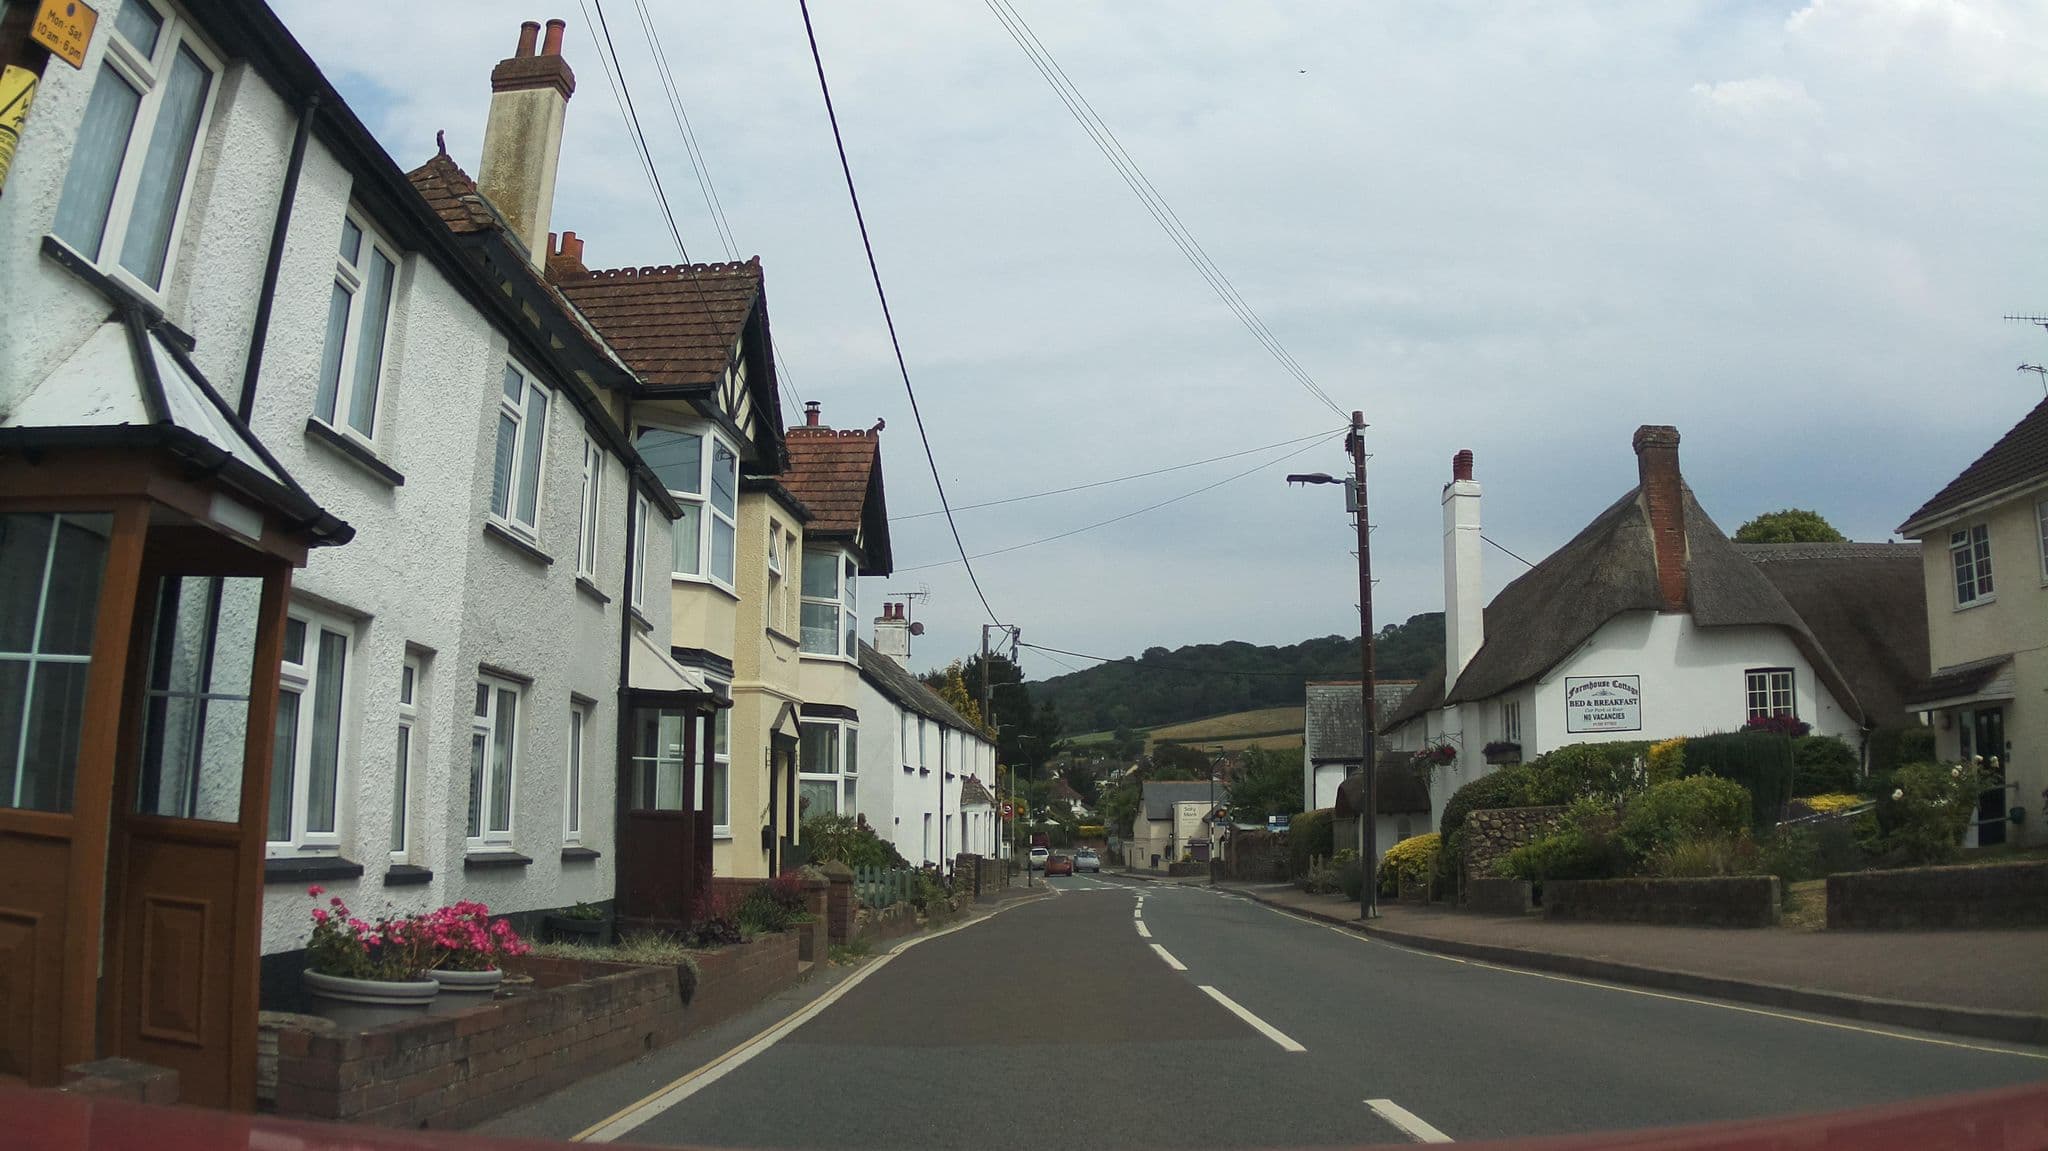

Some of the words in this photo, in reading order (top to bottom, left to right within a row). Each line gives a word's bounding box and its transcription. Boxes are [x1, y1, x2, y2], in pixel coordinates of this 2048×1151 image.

[47, 9, 64, 28] Mon
[68, 25, 82, 42] Sat
[36, 21, 47, 35] 10
[46, 31, 59, 44] am
[63, 40, 70, 51] 6
[68, 46, 81, 59] pm
[1568, 680, 1610, 699] Farmhouse
[1594, 698, 1638, 706] BREAKFAST
